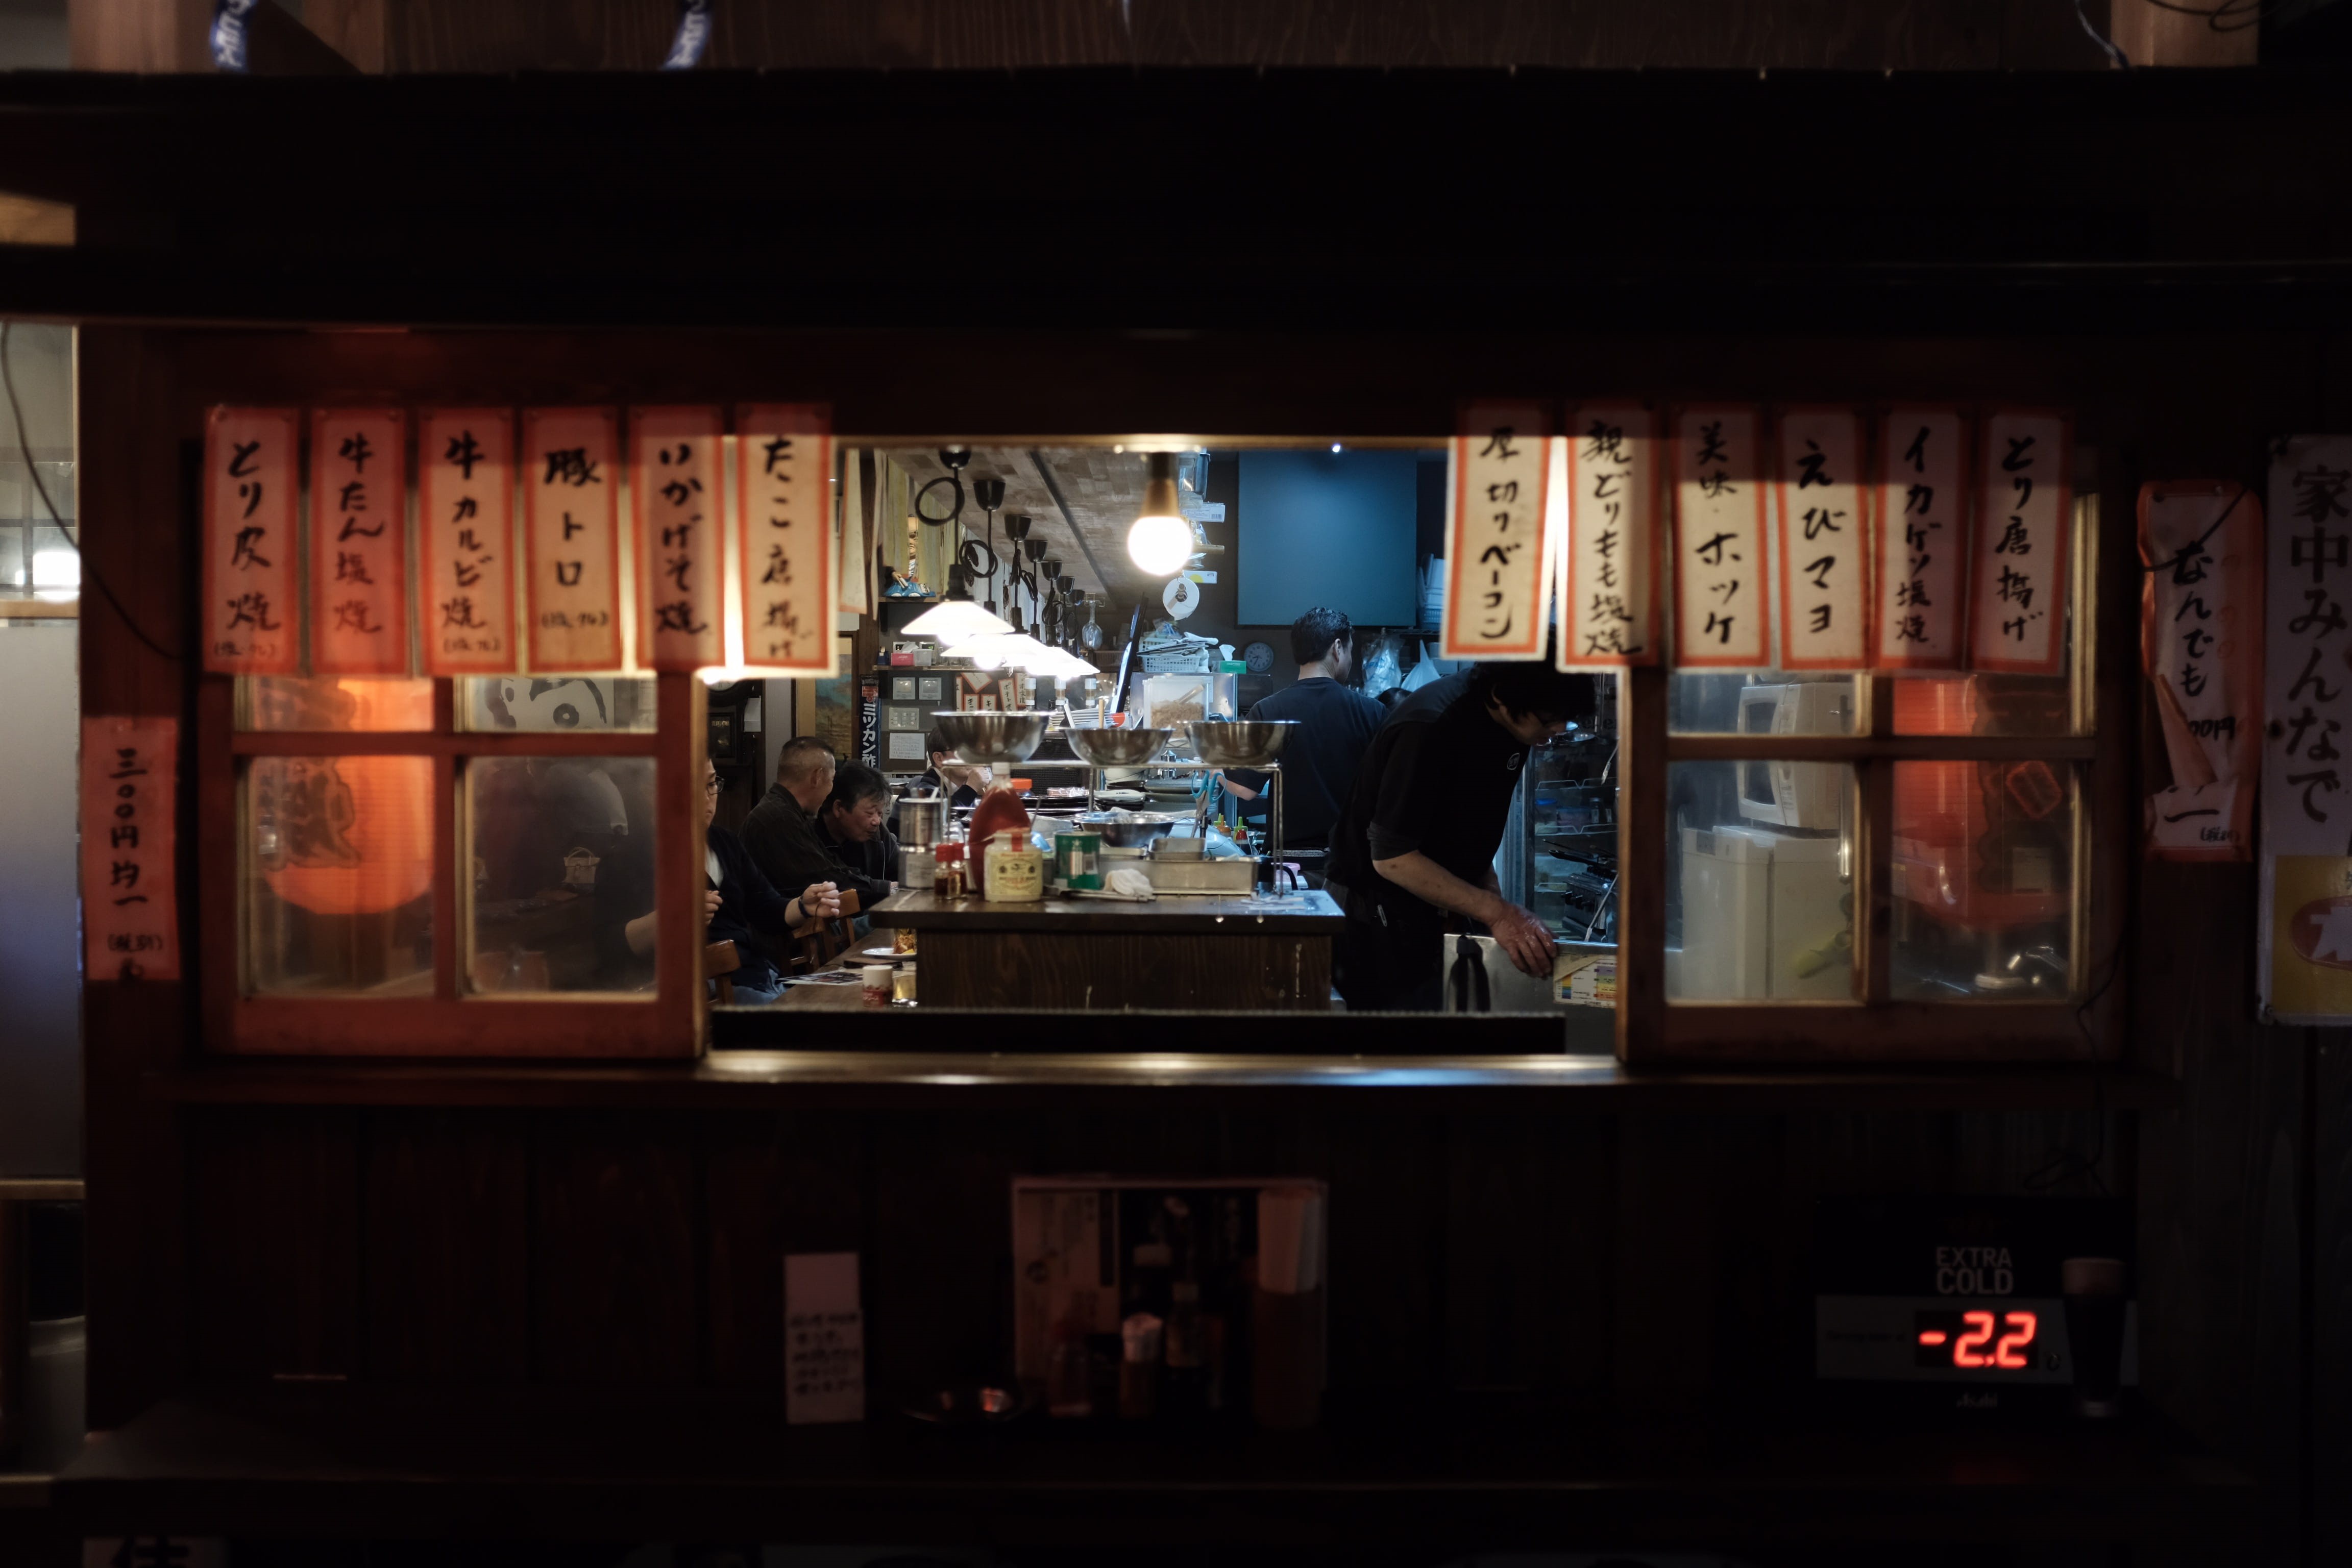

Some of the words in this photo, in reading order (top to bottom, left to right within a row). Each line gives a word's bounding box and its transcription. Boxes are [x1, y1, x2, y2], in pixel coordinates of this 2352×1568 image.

[544, 447, 601, 586] 豚トロ
[1480, 426, 1522, 639] 厚切りベーコン
[1797, 439, 1847, 633] えびマヨ
[1996, 437, 2043, 641] とり唐揚げ
[2173, 541, 2213, 696] なんでも
[2287, 465, 2351, 822] 家中みんなで
[862, 703, 877, 768] ミツカン酢
[1935, 1246, 2013, 1268] EXTRA
[1937, 1268, 2014, 1295] COLD
[1918, 1310, 2037, 1368] -2.2
